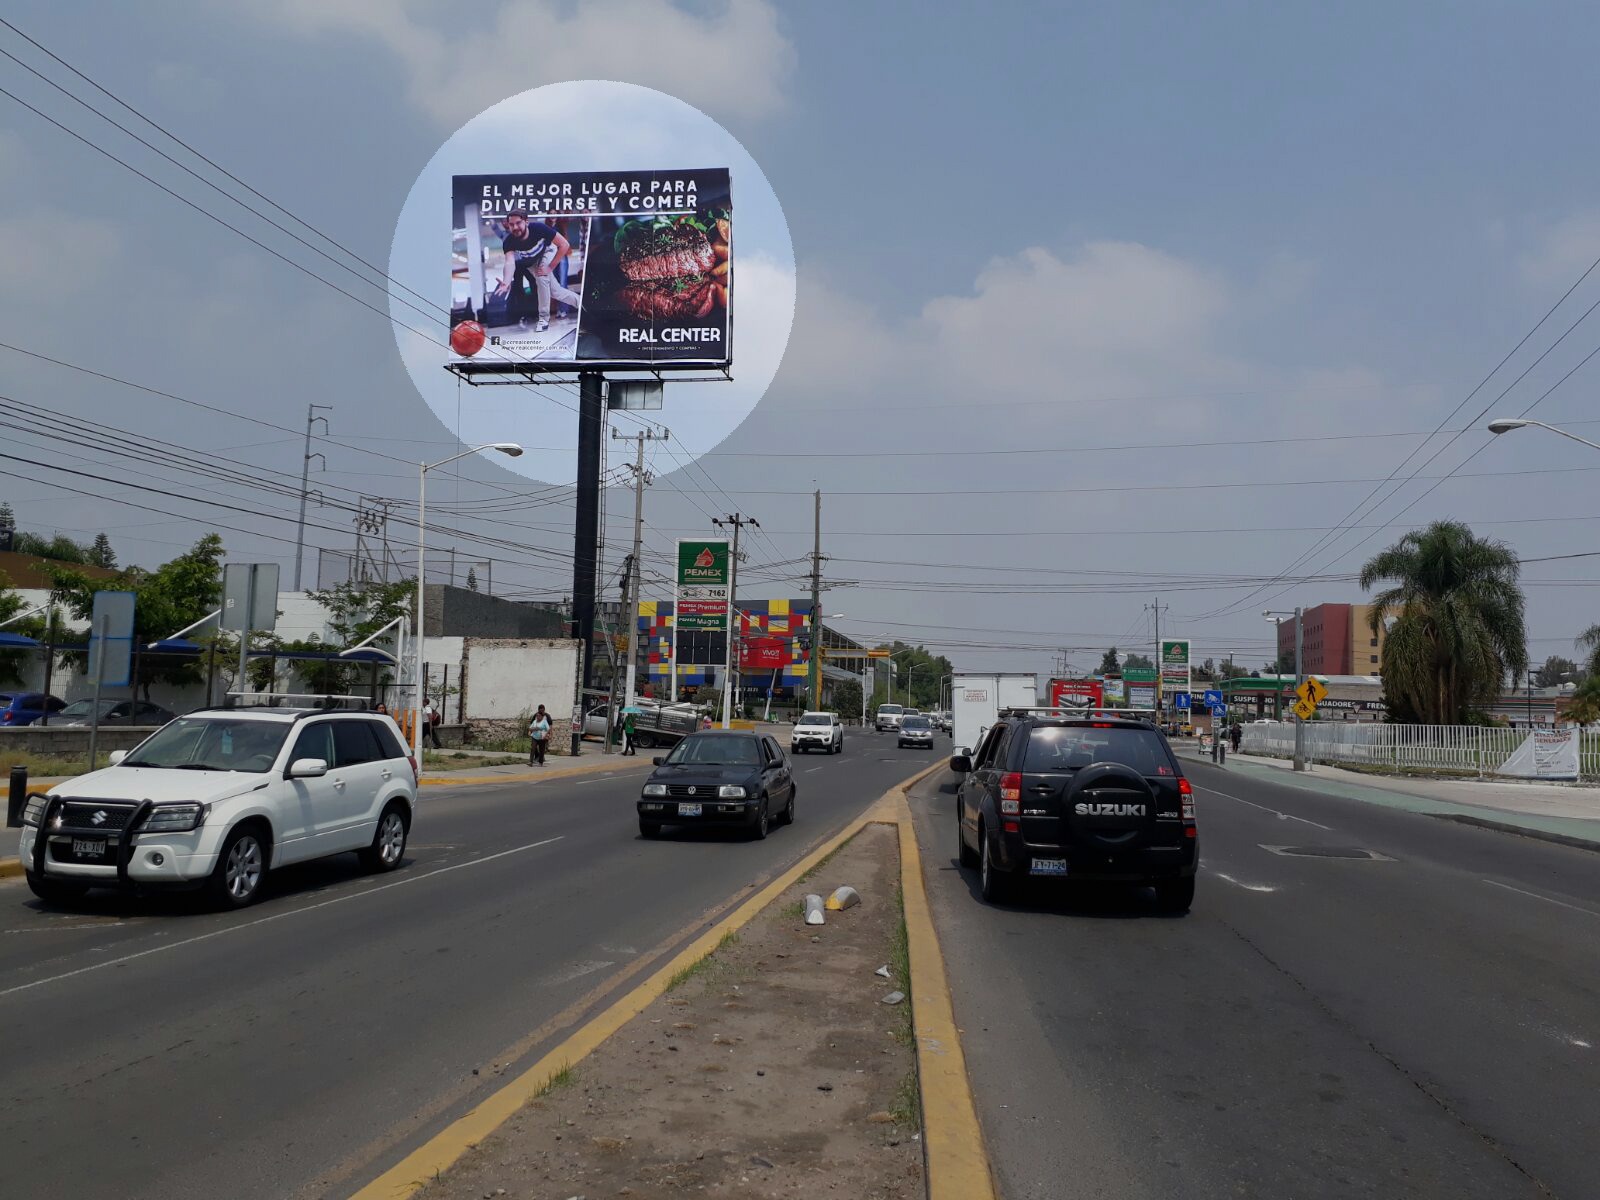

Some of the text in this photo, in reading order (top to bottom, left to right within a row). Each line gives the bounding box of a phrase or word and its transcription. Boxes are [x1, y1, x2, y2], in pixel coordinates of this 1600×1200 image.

[483, 180, 698, 197] EL MEJOR LUGAR PARA
[481, 194, 697, 212] DIVERTIRSE Y COMER
[619, 327, 721, 343] REAL CENTER
[684, 568, 722, 577] PEMEX
[708, 589, 726, 597] 7162
[697, 618, 720, 627] Magna
[1075, 803, 1146, 816] SUZUKI
